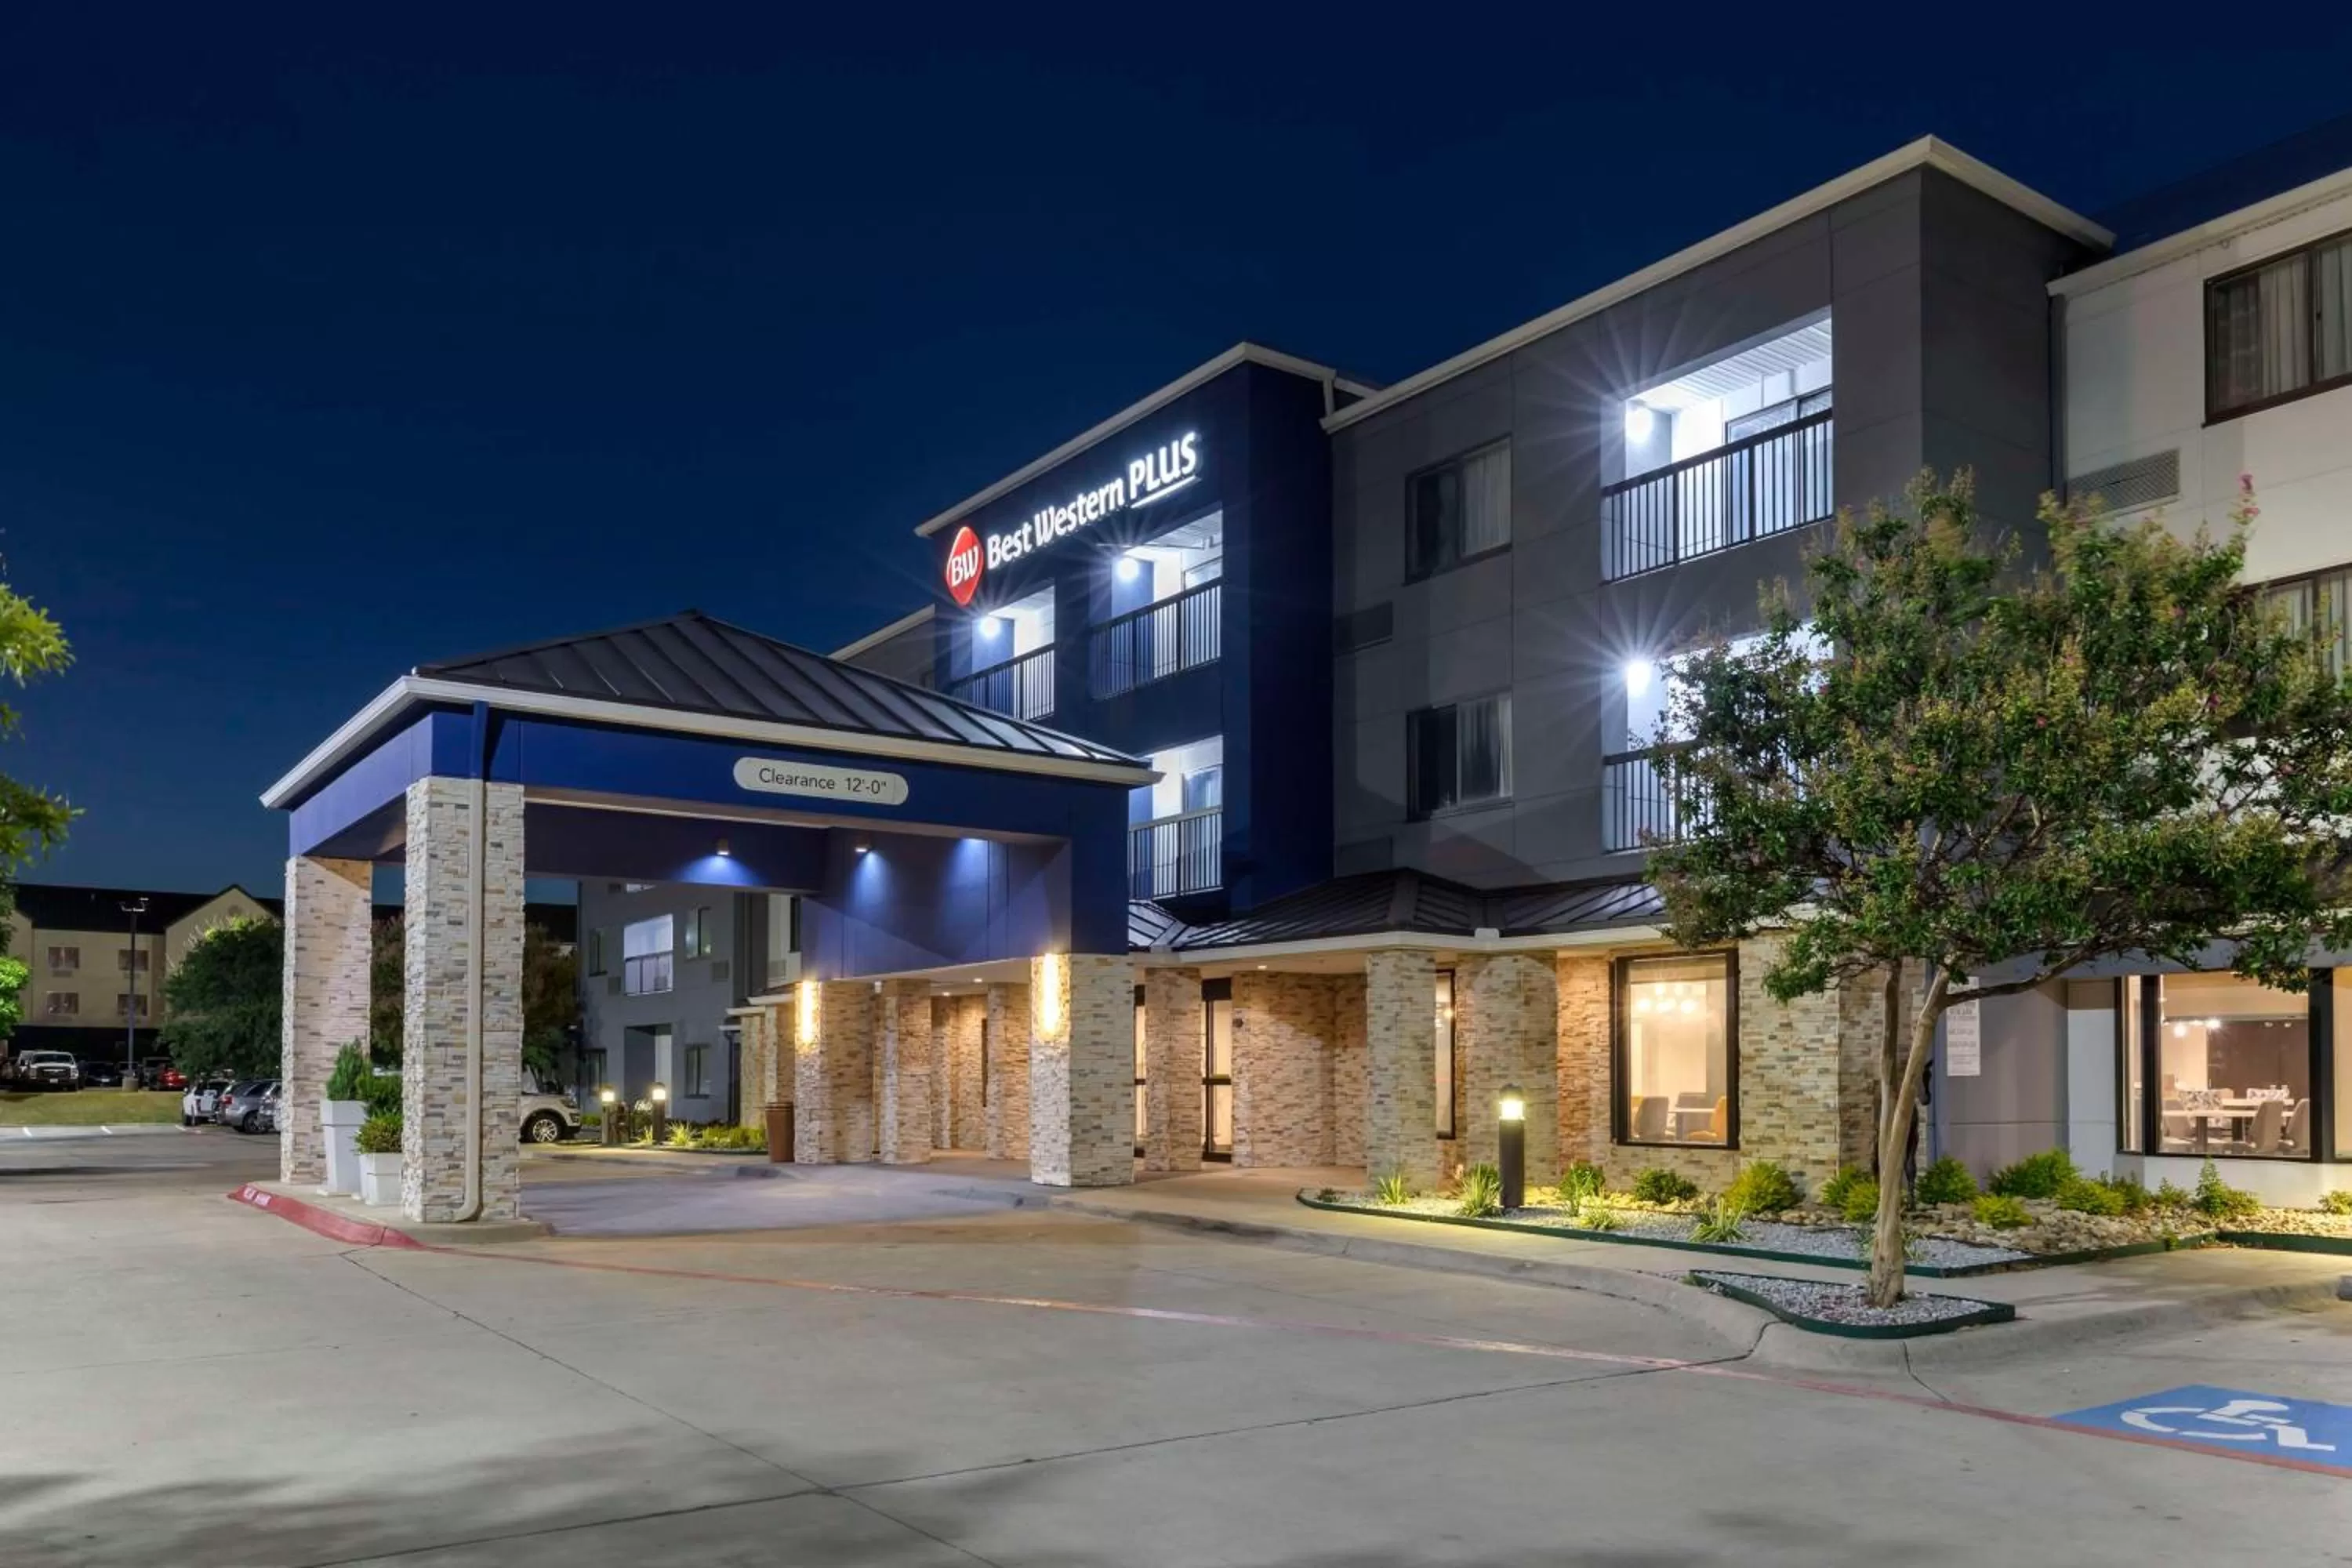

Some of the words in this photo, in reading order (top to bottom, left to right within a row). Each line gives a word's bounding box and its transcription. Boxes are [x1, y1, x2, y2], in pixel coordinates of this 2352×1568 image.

[987, 522, 1033, 569] Best
[1034, 478, 1124, 546] Western
[1130, 432, 1196, 499] PLUS
[951, 546, 978, 587] BW
[758, 768, 835, 789] Clearance
